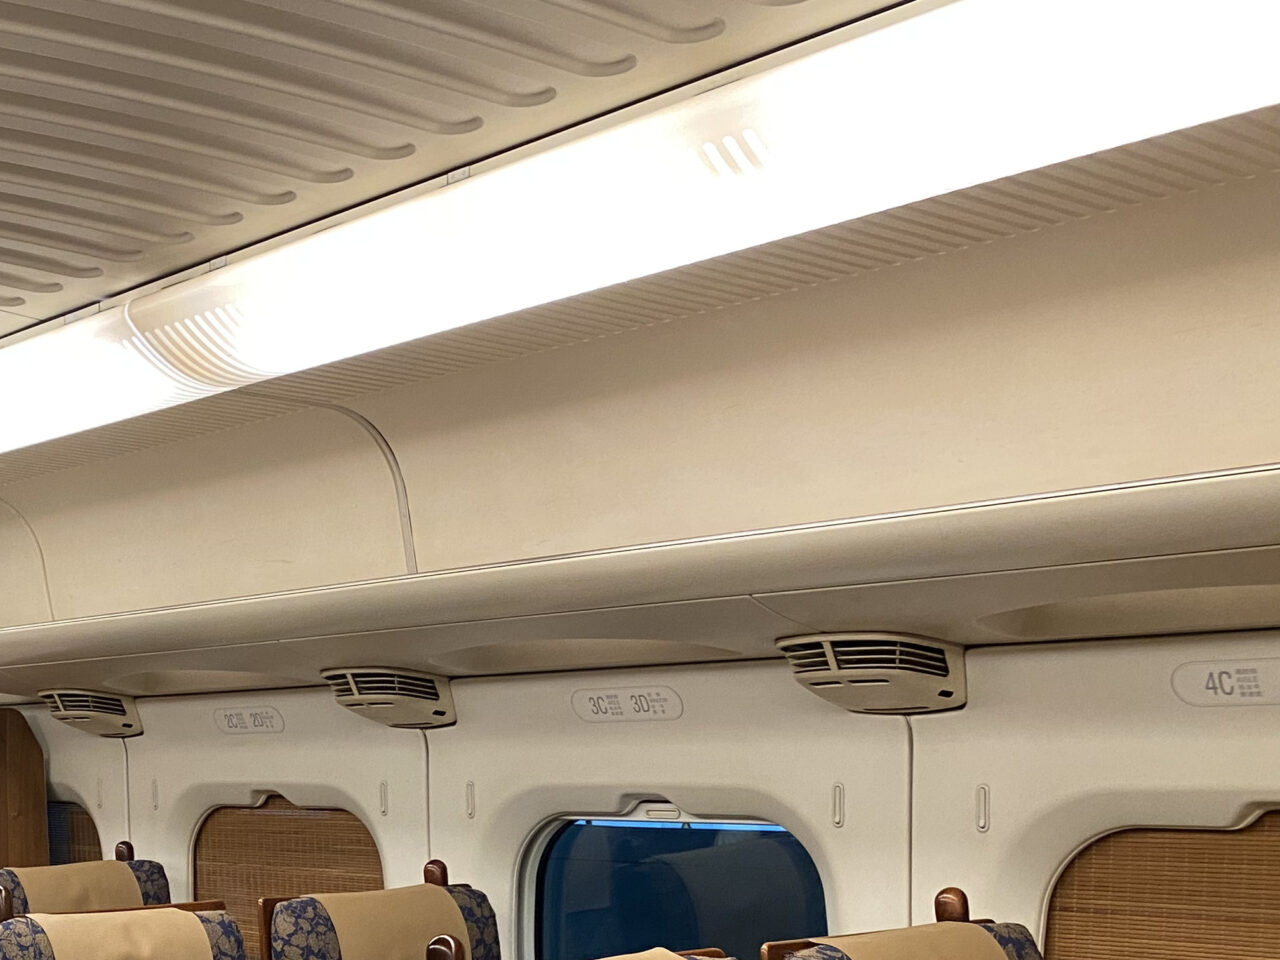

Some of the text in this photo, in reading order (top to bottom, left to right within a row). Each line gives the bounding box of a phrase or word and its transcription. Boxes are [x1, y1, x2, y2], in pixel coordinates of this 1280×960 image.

[1205, 671, 1235, 696] 4C
[588, 696, 608, 715] 3C
[630, 694, 650, 713] 3D
